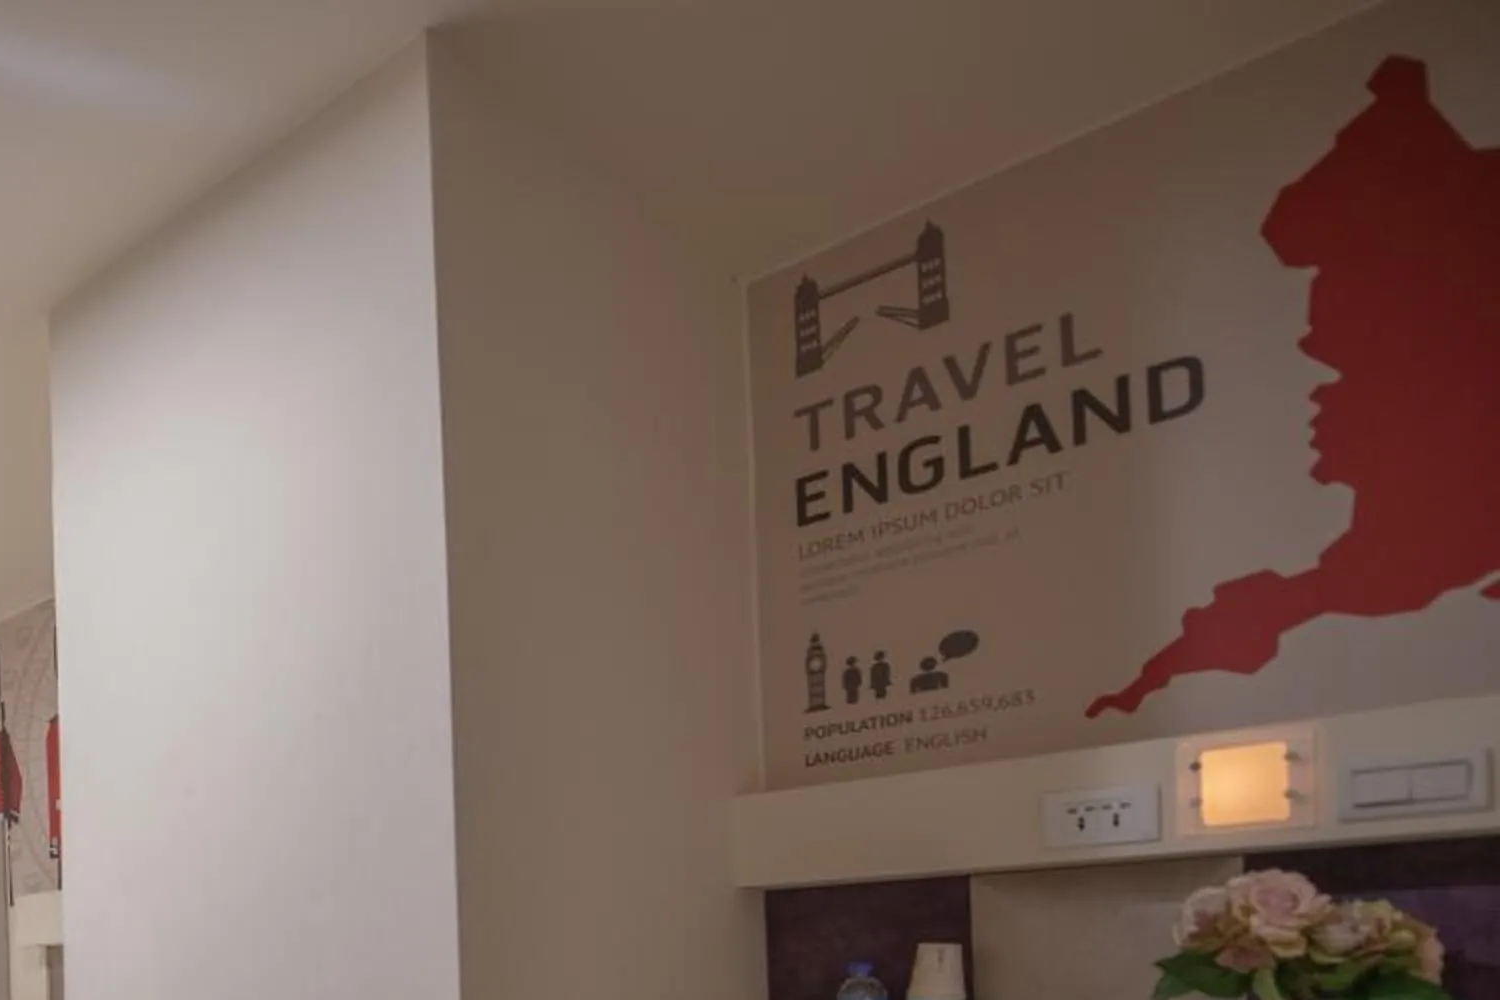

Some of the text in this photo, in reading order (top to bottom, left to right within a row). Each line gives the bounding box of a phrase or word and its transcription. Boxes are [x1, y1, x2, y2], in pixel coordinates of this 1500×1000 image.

[794, 312, 1103, 451] TRAVEL
[794, 356, 1206, 527] ENGLAND
[799, 529, 865, 561] LOREM
[872, 508, 938, 540] IPSUM
[945, 483, 1023, 520] DOLOR
[1029, 471, 1070, 496] SIT
[803, 709, 914, 741] POPULATION
[804, 727, 988, 768] LANGUAGE ENGLISH
